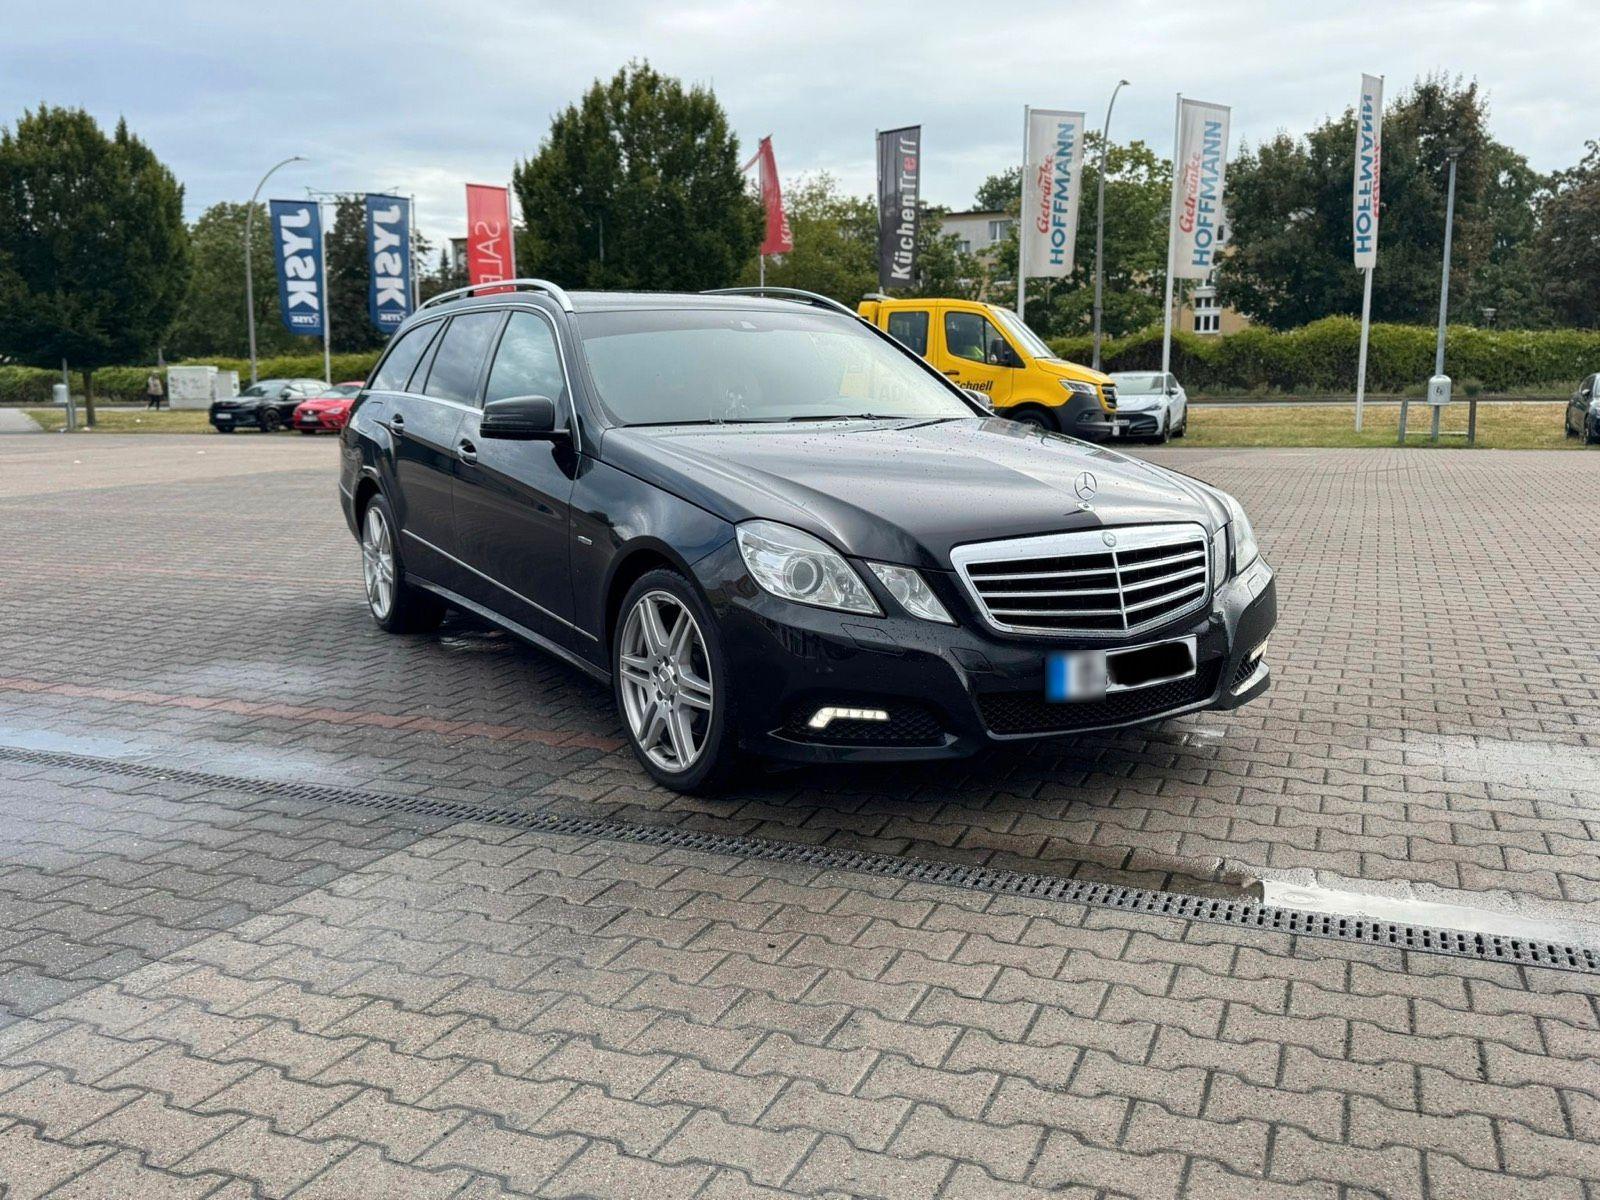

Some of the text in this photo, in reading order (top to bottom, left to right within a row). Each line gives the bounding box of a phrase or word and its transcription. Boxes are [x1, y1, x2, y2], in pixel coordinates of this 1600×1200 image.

[890, 137, 918, 280] KüchenTreff
[1035, 155, 1054, 234] Getränke
[1049, 123, 1075, 265] HOFFMANN
[1180, 151, 1201, 234] Getränke
[1192, 120, 1222, 266] HOFFMANN
[954, 380, 994, 391] Schnell
